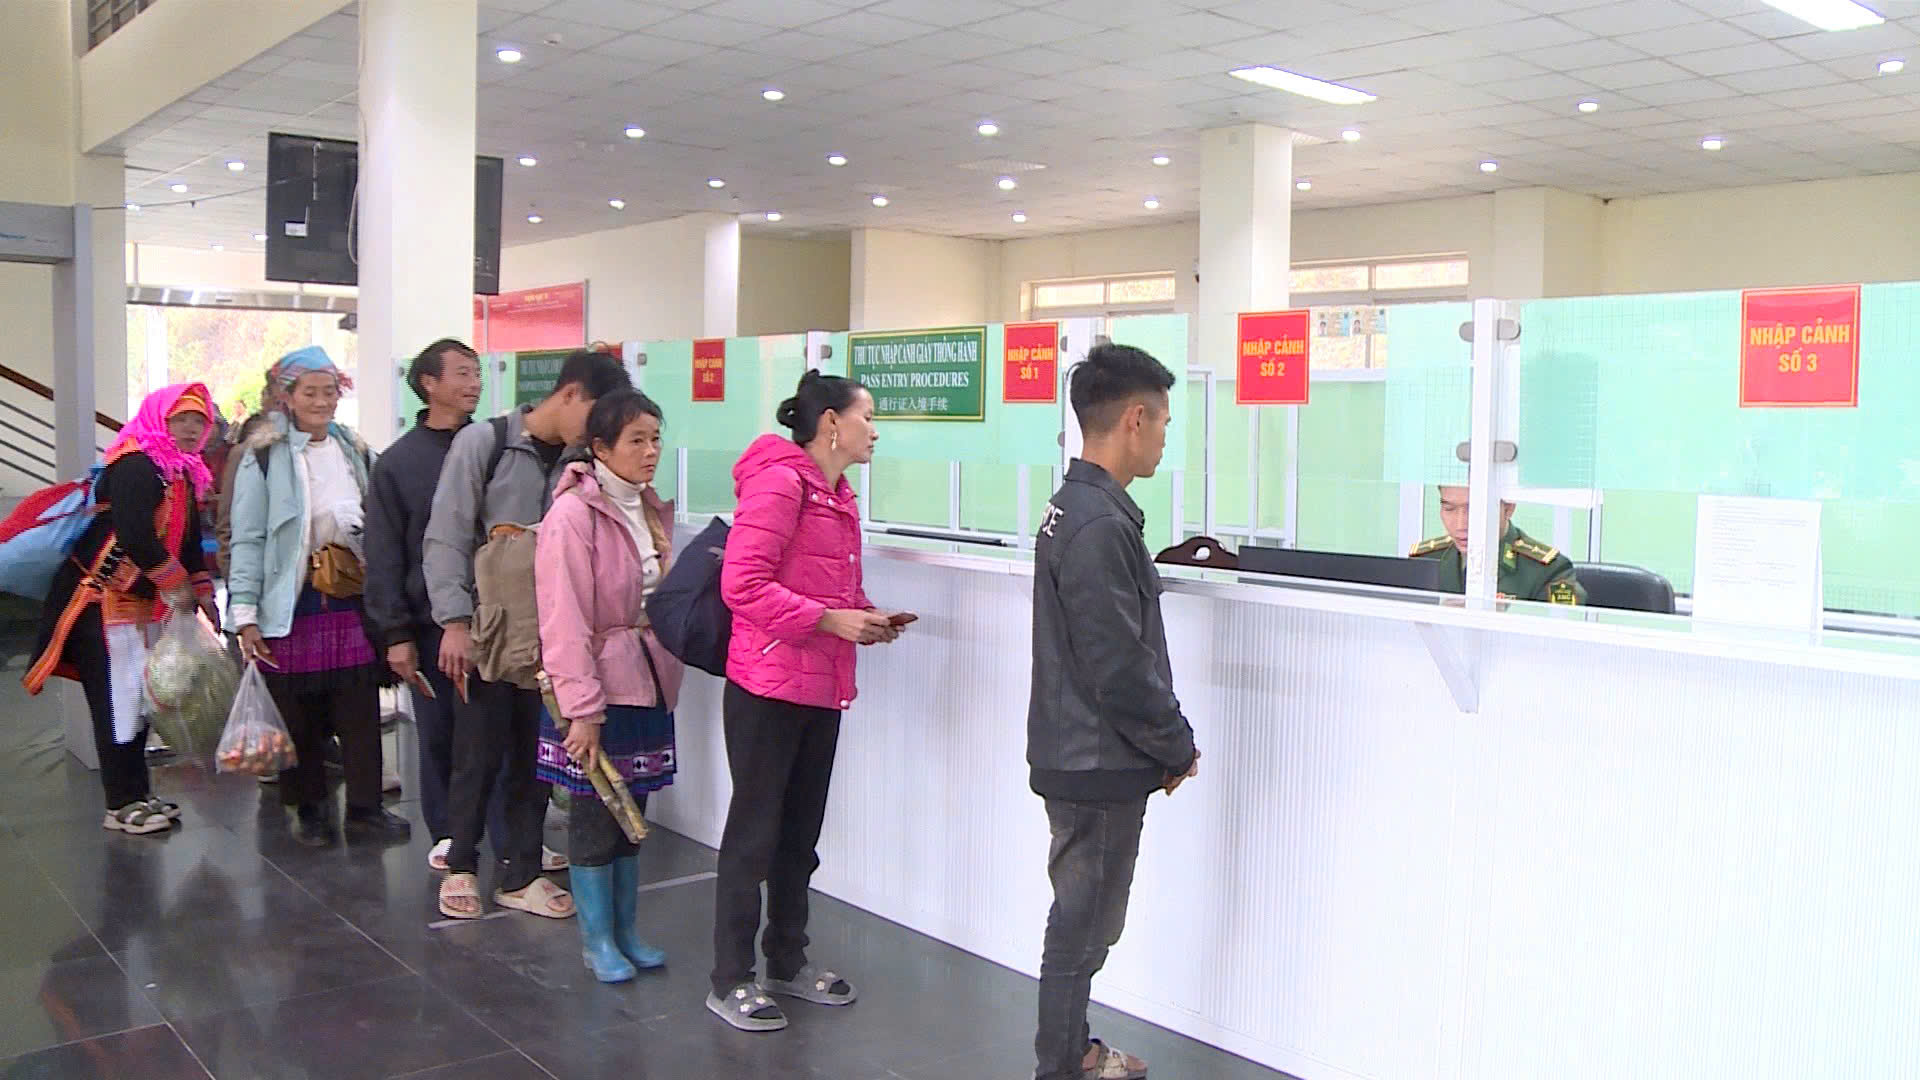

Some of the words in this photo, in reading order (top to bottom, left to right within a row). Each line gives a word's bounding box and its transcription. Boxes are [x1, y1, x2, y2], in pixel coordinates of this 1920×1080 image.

[1750, 322, 1796, 350] NHẬP
[1801, 317, 1850, 344] CẢNH
[1007, 346, 1030, 365] NHẬP
[1031, 343, 1054, 361] CẢNH
[1242, 338, 1272, 359] NHẬP
[1274, 334, 1305, 355] CẢNH
[1020, 362, 1033, 380] SỐ
[1033, 367, 1039, 380] 1
[1260, 357, 1276, 377] SỐ
[1277, 361, 1286, 377] 2
[1778, 347, 1803, 373] SỐ
[1806, 352, 1818, 373] 3
[860, 373, 880, 388] PASS
[881, 372, 910, 388] ENTRY
[910, 371, 970, 388] PROCEDURES
